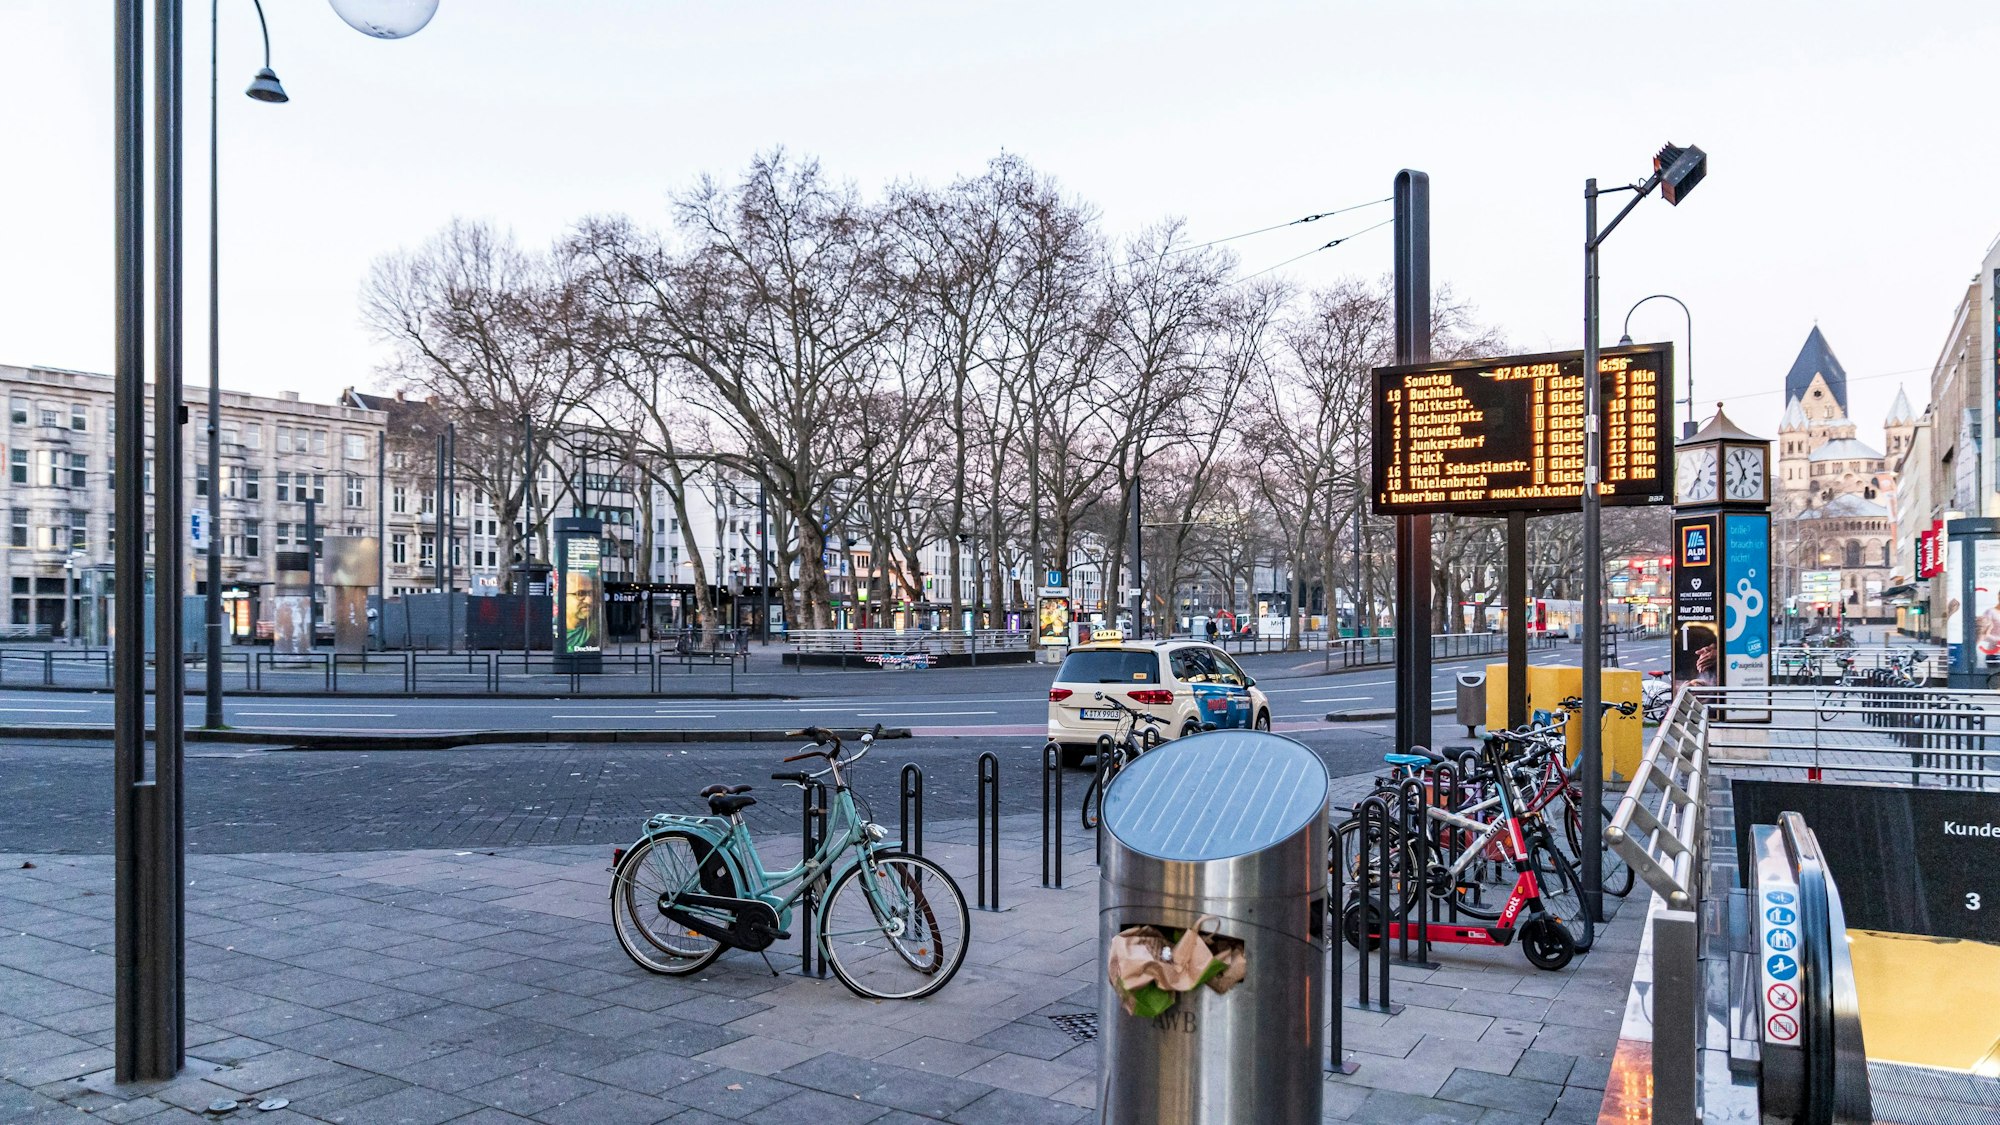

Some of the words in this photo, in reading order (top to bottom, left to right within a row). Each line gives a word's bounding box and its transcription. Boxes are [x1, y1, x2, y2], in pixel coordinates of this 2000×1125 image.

[1387, 389, 1401, 402] 18
[1410, 386, 1463, 400] Buchheim
[1551, 375, 1584, 389] Gleis
[1617, 371, 1626, 384] 5
[1632, 369, 1656, 383] Min
[1404, 374, 1452, 388] Sonntag
[1497, 363, 1560, 380] 07.03.2021
[1393, 402, 1401, 414] 7
[1410, 398, 1474, 413] Moltkestr.
[1551, 389, 1584, 403] Gleis
[1617, 385, 1626, 398] 9
[1632, 383, 1656, 397] Min
[1393, 415, 1401, 427] 4
[1410, 410, 1483, 426] Rochusplatz
[1551, 402, 1584, 416] Gleis
[1632, 397, 1656, 411] Min
[1393, 428, 1401, 440] 3
[1410, 424, 1461, 438] Holweide
[1551, 416, 1584, 429] Gleis
[1610, 412, 1626, 426] 11
[1632, 411, 1656, 425] Min
[1394, 440, 1401, 452] 1
[1410, 435, 1485, 451] Junkersdorf
[1551, 429, 1584, 442] Gleis
[1609, 426, 1626, 440] 12
[1632, 425, 1656, 438] Min
[1394, 453, 1401, 465] 1
[1410, 451, 1444, 464] Brück
[1551, 443, 1584, 456] Gleis
[1609, 440, 1626, 453] 12
[1632, 439, 1656, 452] Min
[1387, 466, 1401, 478] 16
[1410, 463, 1440, 477] Niehl
[1446, 460, 1531, 475] Sebastianstr.
[1551, 456, 1584, 470] Gleis
[1609, 453, 1626, 467] 13
[1632, 452, 1656, 466] Min
[1387, 478, 1401, 491] 18
[1410, 475, 1488, 490] Thielenbruch
[1551, 470, 1584, 483] Gleis
[1609, 467, 1626, 480] 16
[1632, 466, 1656, 479] Min
[1391, 490, 1445, 503] bewerben
[1450, 488, 1485, 501] unter
[1687, 548, 1706, 556] ALDI
[1050, 573, 1059, 584] U
[1084, 709, 1089, 717] K
[1944, 821, 2000, 837] Kunde
[1506, 897, 1520, 918] dott
[1965, 892, 1981, 910] 3
